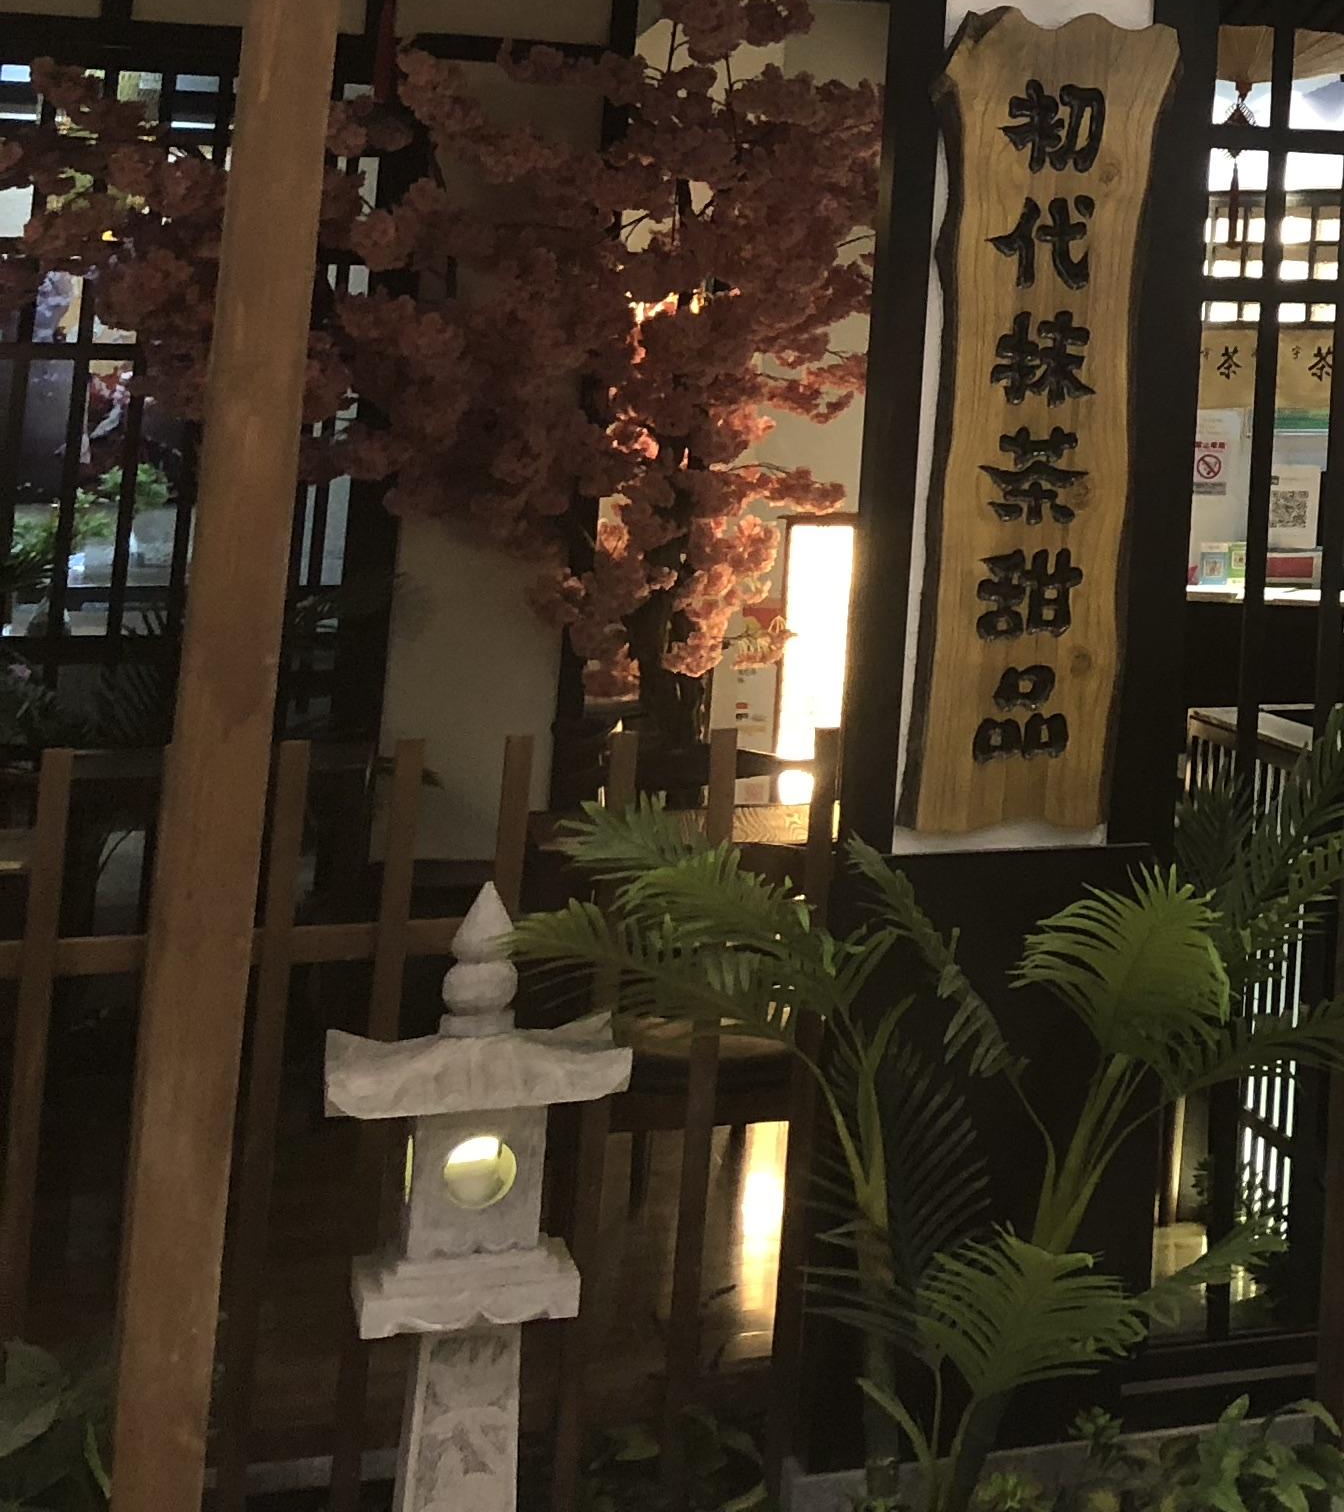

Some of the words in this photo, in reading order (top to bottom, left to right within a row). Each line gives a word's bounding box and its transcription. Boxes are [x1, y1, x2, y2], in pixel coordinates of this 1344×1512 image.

[971, 78, 1106, 764] 初代抹茶甜品
